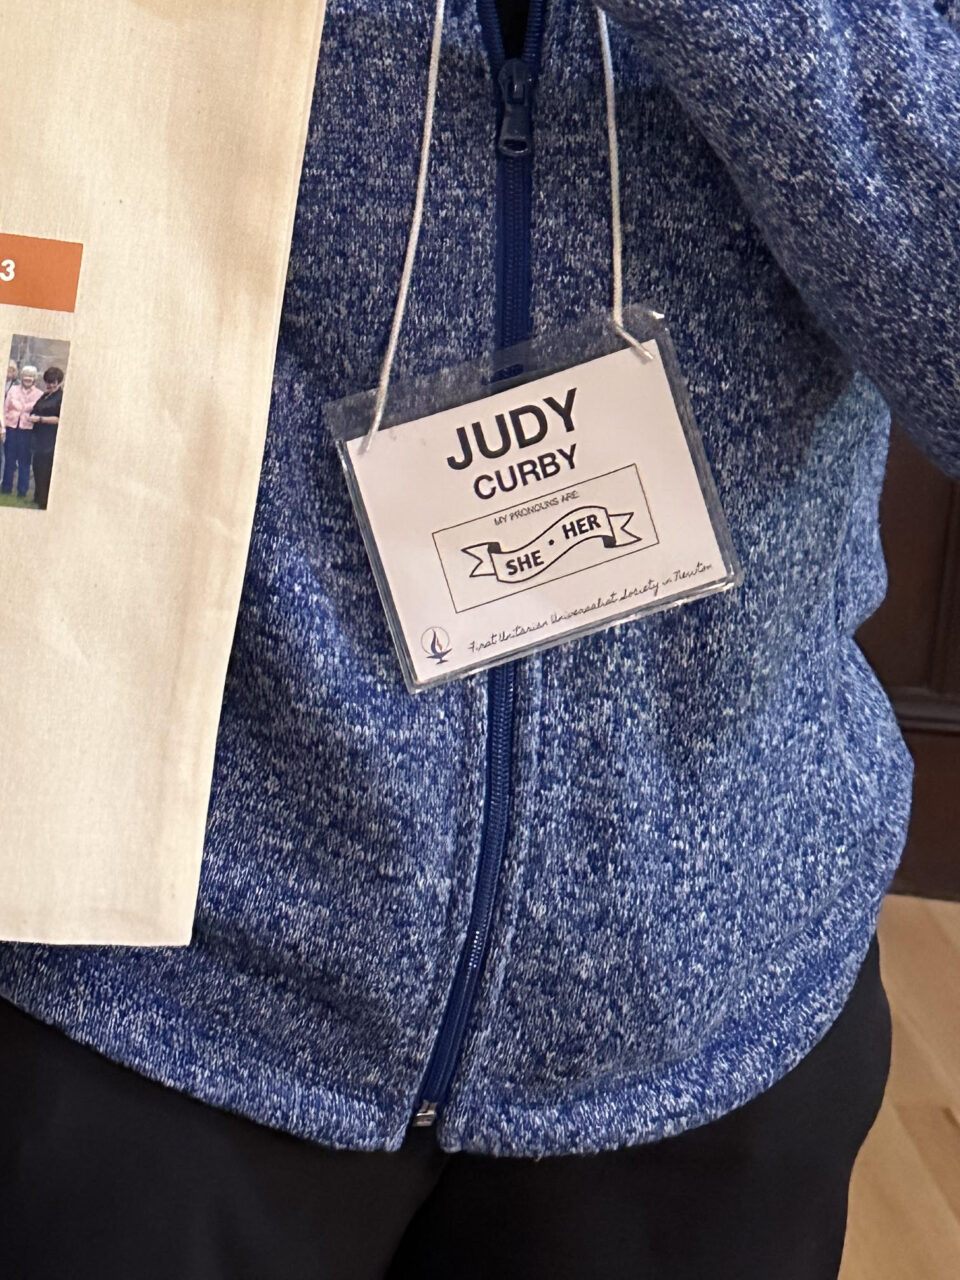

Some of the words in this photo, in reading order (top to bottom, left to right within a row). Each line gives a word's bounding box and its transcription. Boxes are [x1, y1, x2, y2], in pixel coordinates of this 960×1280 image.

[446, 387, 577, 470] JUDY
[473, 443, 577, 500] CURBY
[493, 515, 508, 526] MY
[508, 497, 560, 521] PRONOUNS
[560, 490, 581, 504] ARE
[505, 549, 545, 576] SHE
[561, 513, 602, 540] HER
[467, 633, 498, 653] First
[498, 619, 549, 642] Unitarian
[618, 578, 660, 597] Society
[672, 560, 713, 581] Newton
